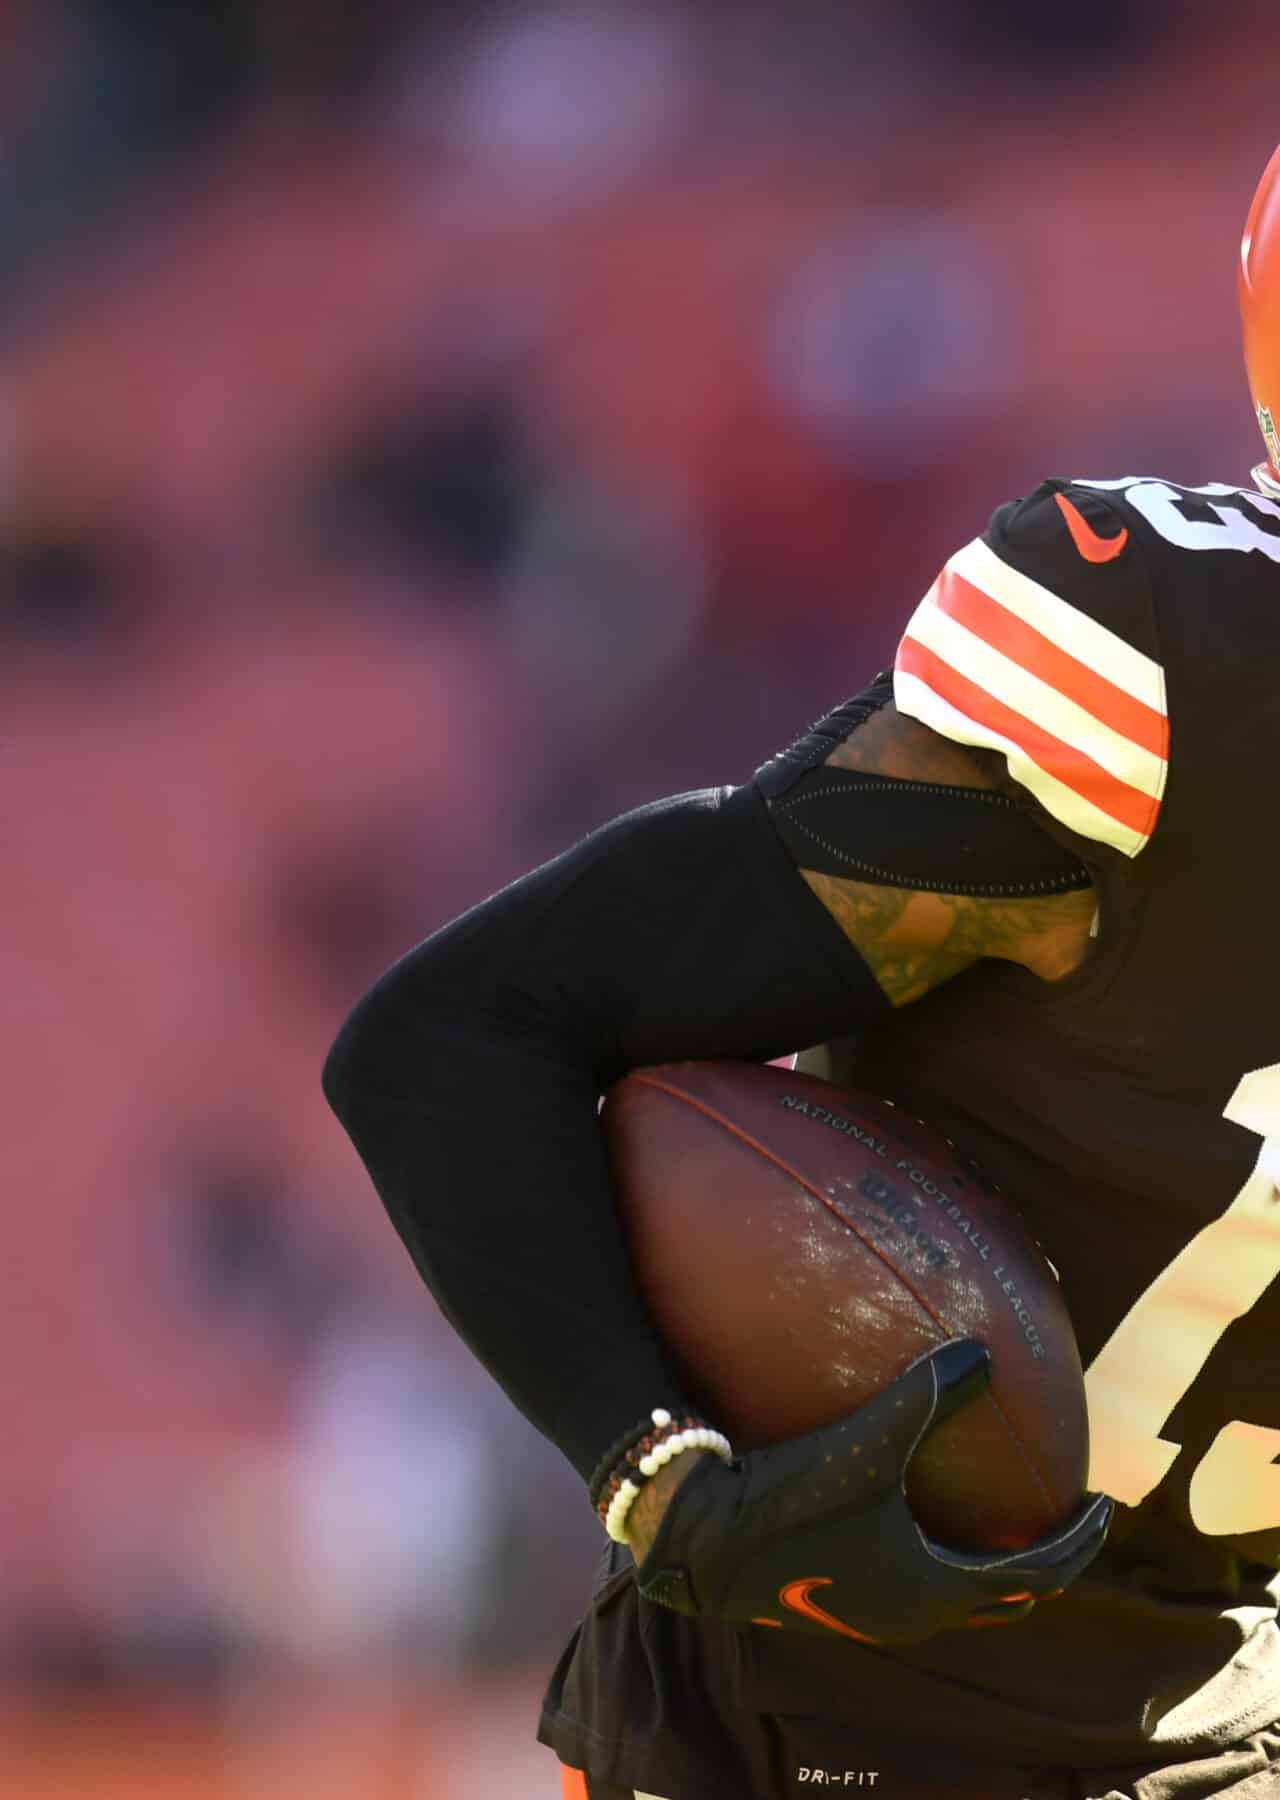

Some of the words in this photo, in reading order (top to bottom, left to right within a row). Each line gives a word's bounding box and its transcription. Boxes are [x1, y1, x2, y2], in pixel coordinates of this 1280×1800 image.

[780, 1095, 888, 1157] NATIONAL
[897, 1159, 992, 1261] FOOTBALL
[993, 1266, 1045, 1360] LEAGUE
[798, 1767, 879, 1786] DRI-FIT
